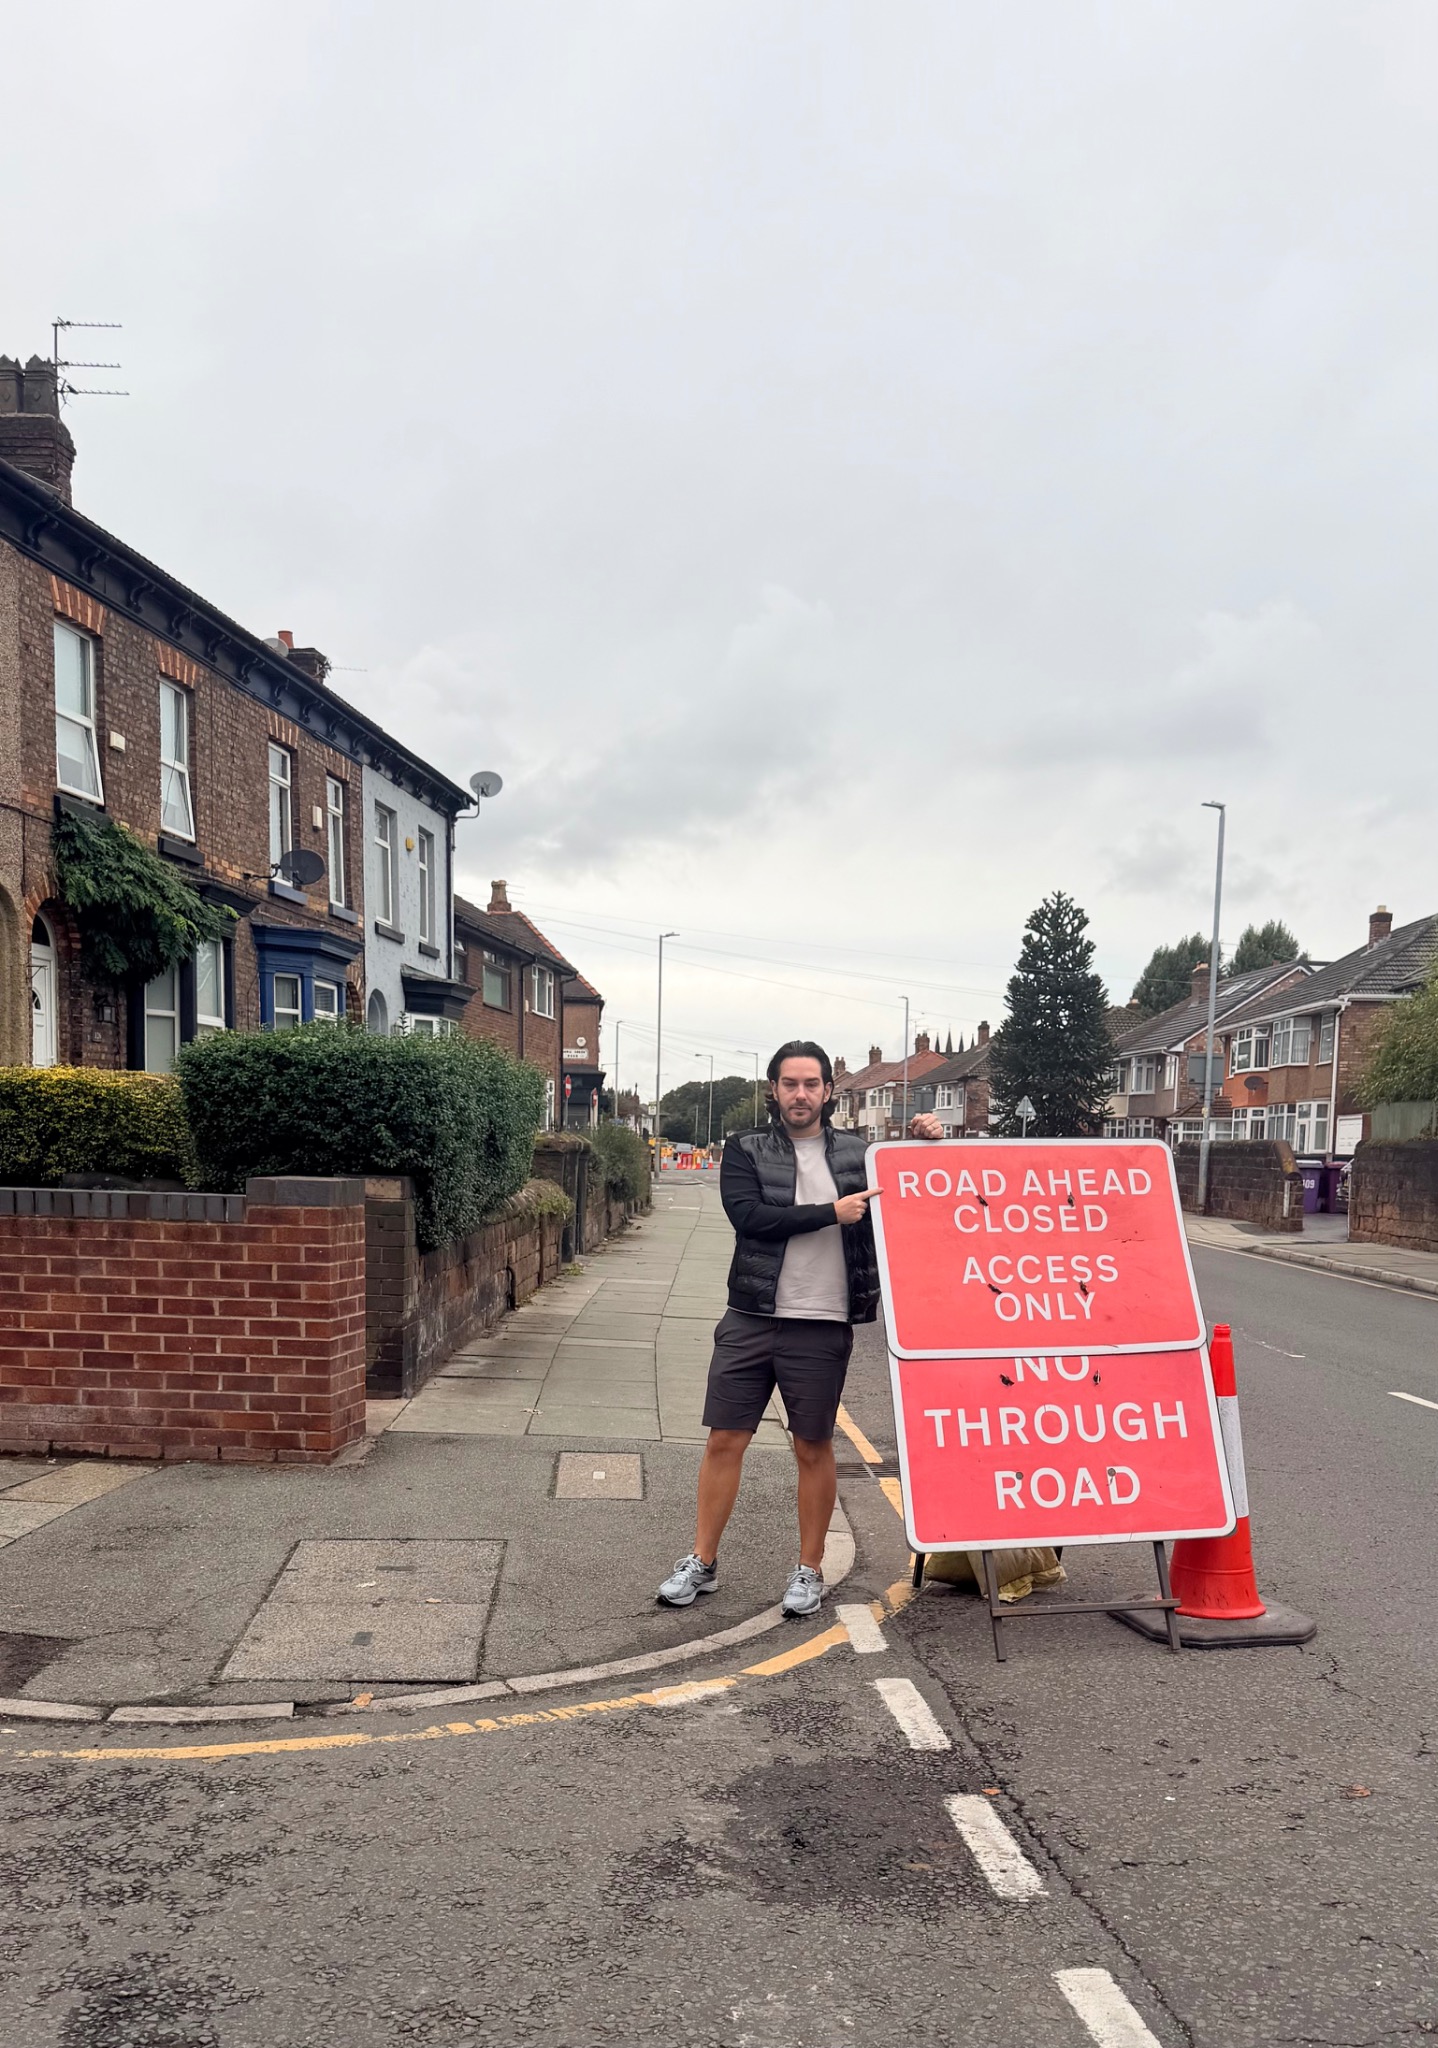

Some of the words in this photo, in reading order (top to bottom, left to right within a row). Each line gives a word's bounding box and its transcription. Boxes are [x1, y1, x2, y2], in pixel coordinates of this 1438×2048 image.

[898, 1168, 1007, 1198] ROAD
[1022, 1168, 1152, 1196] AHEAD
[953, 1204, 1108, 1233] CLOSED
[962, 1254, 1119, 1284] ACCESS
[994, 1291, 1095, 1321] ONLY
[1014, 1356, 1089, 1382] NO
[923, 1400, 1188, 1447] THROUGH
[994, 1465, 1140, 1510] ROAD
